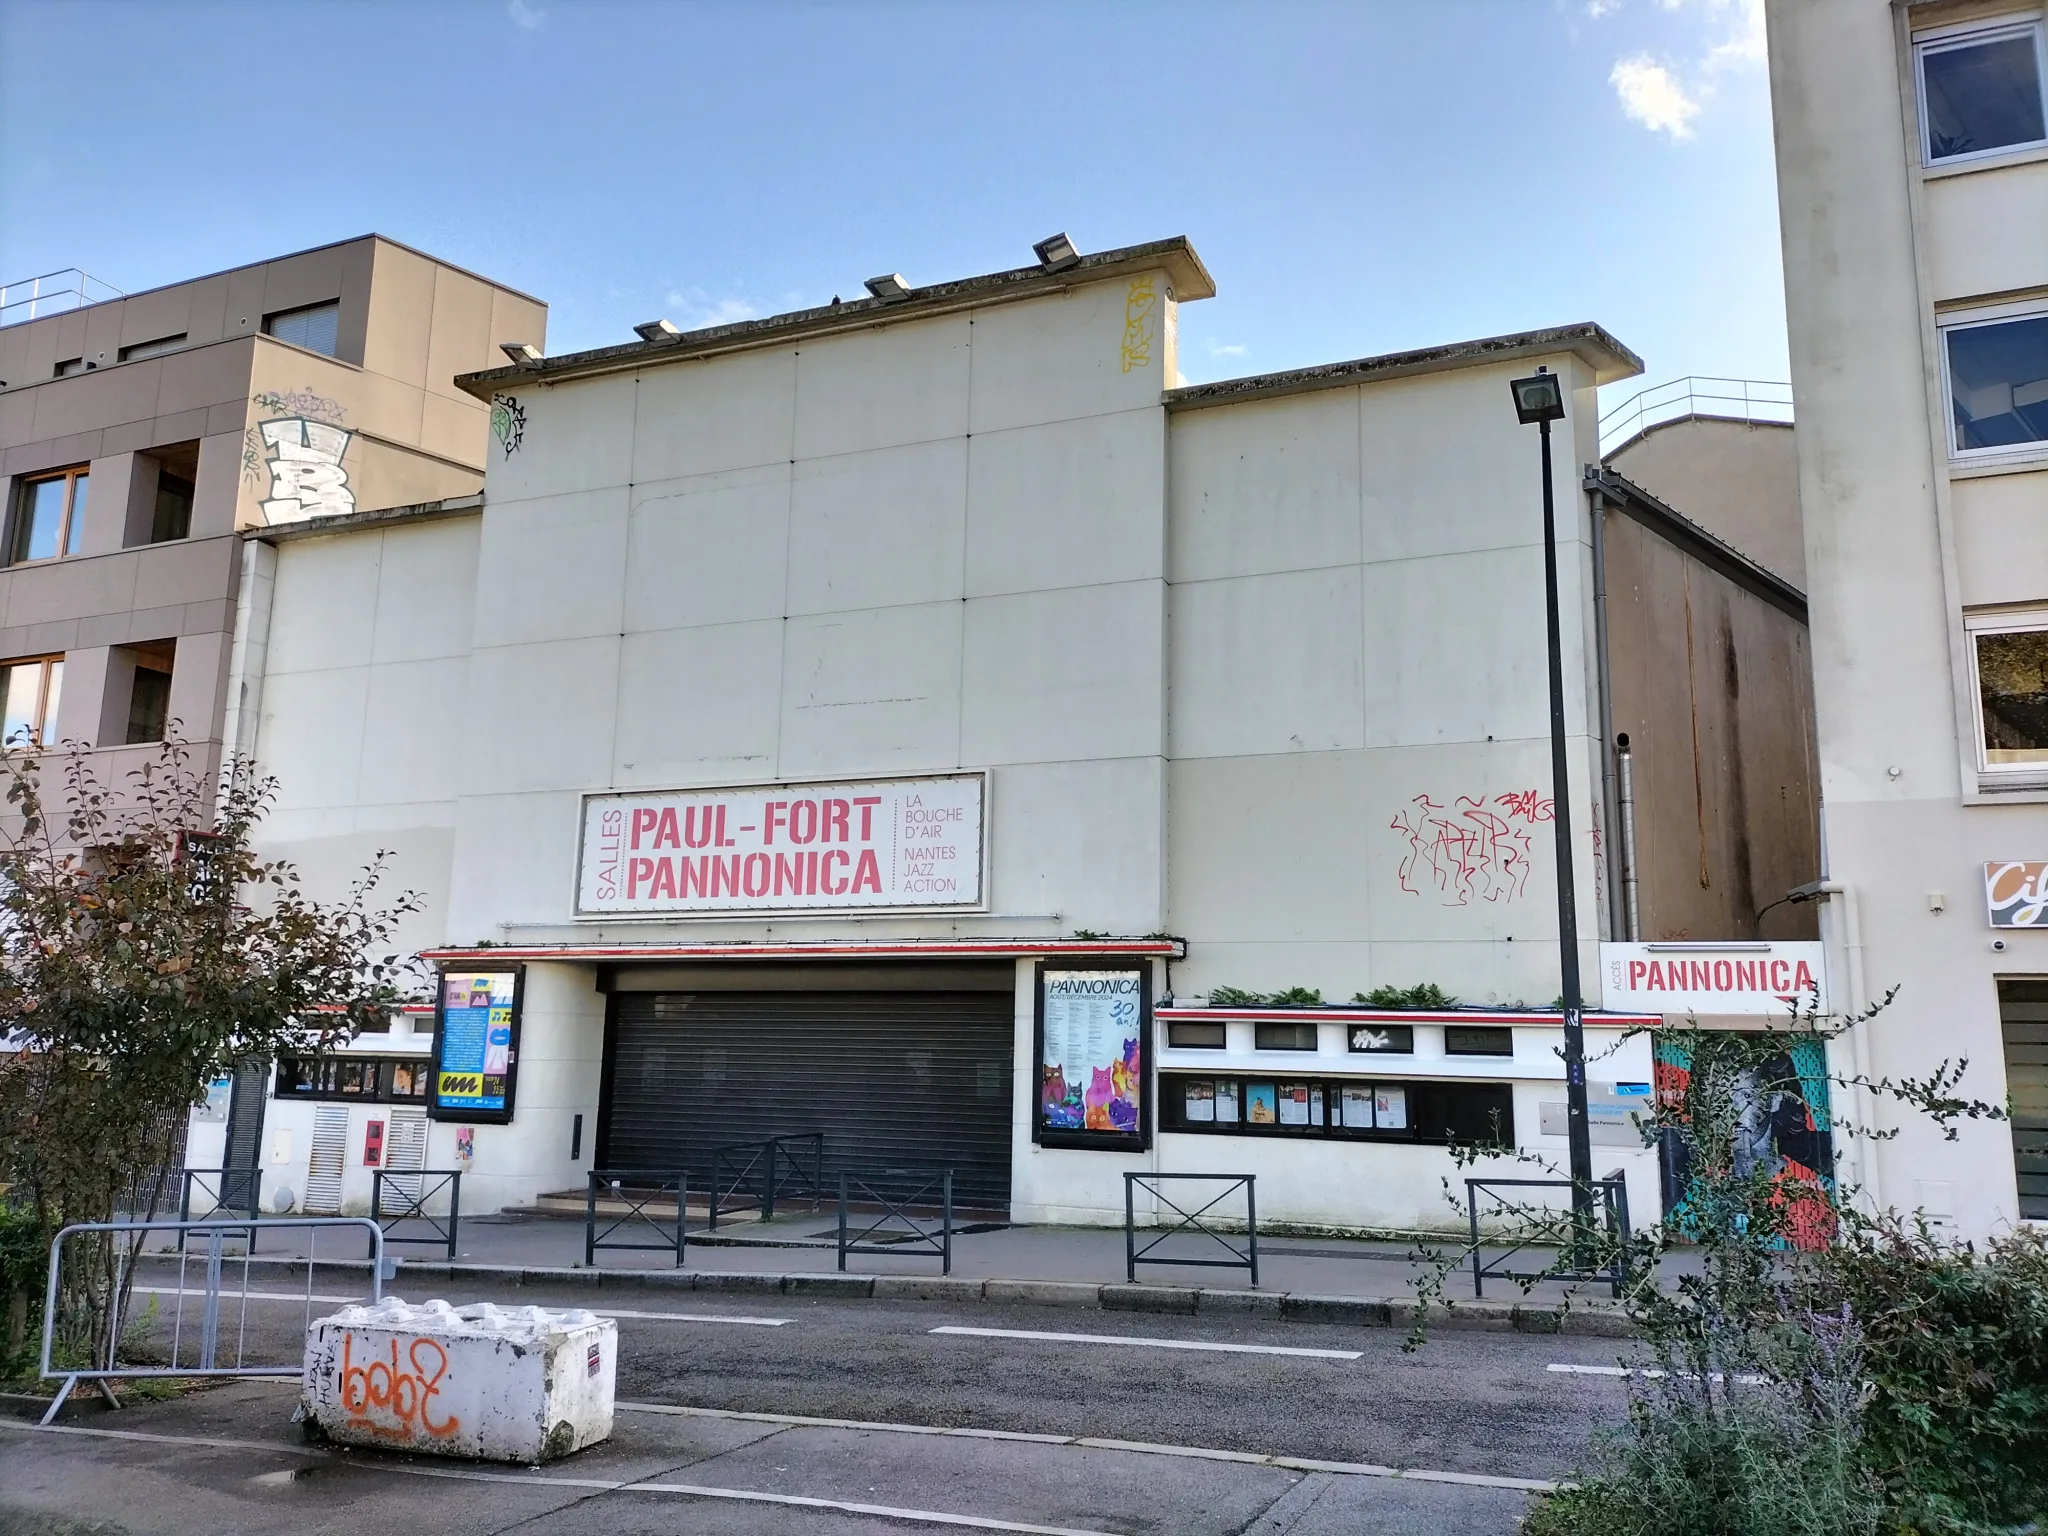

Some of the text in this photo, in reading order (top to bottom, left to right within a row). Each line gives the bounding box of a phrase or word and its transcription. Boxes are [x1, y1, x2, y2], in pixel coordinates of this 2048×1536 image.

[906, 794, 922, 807] LA
[906, 808, 963, 823] BOUCHE
[905, 825, 942, 839] D'AIR
[597, 810, 622, 900] SALLES
[904, 846, 956, 860] NANTES
[627, 849, 882, 900] PANNONICA
[903, 863, 935, 877] JAZZ
[903, 879, 957, 892] ACTION
[1611, 961, 1621, 991] ACCÈS
[1629, 960, 1814, 991] PANNONICA
[1050, 980, 1140, 994] PANNONICA
[1109, 1000, 1134, 1018] 30
